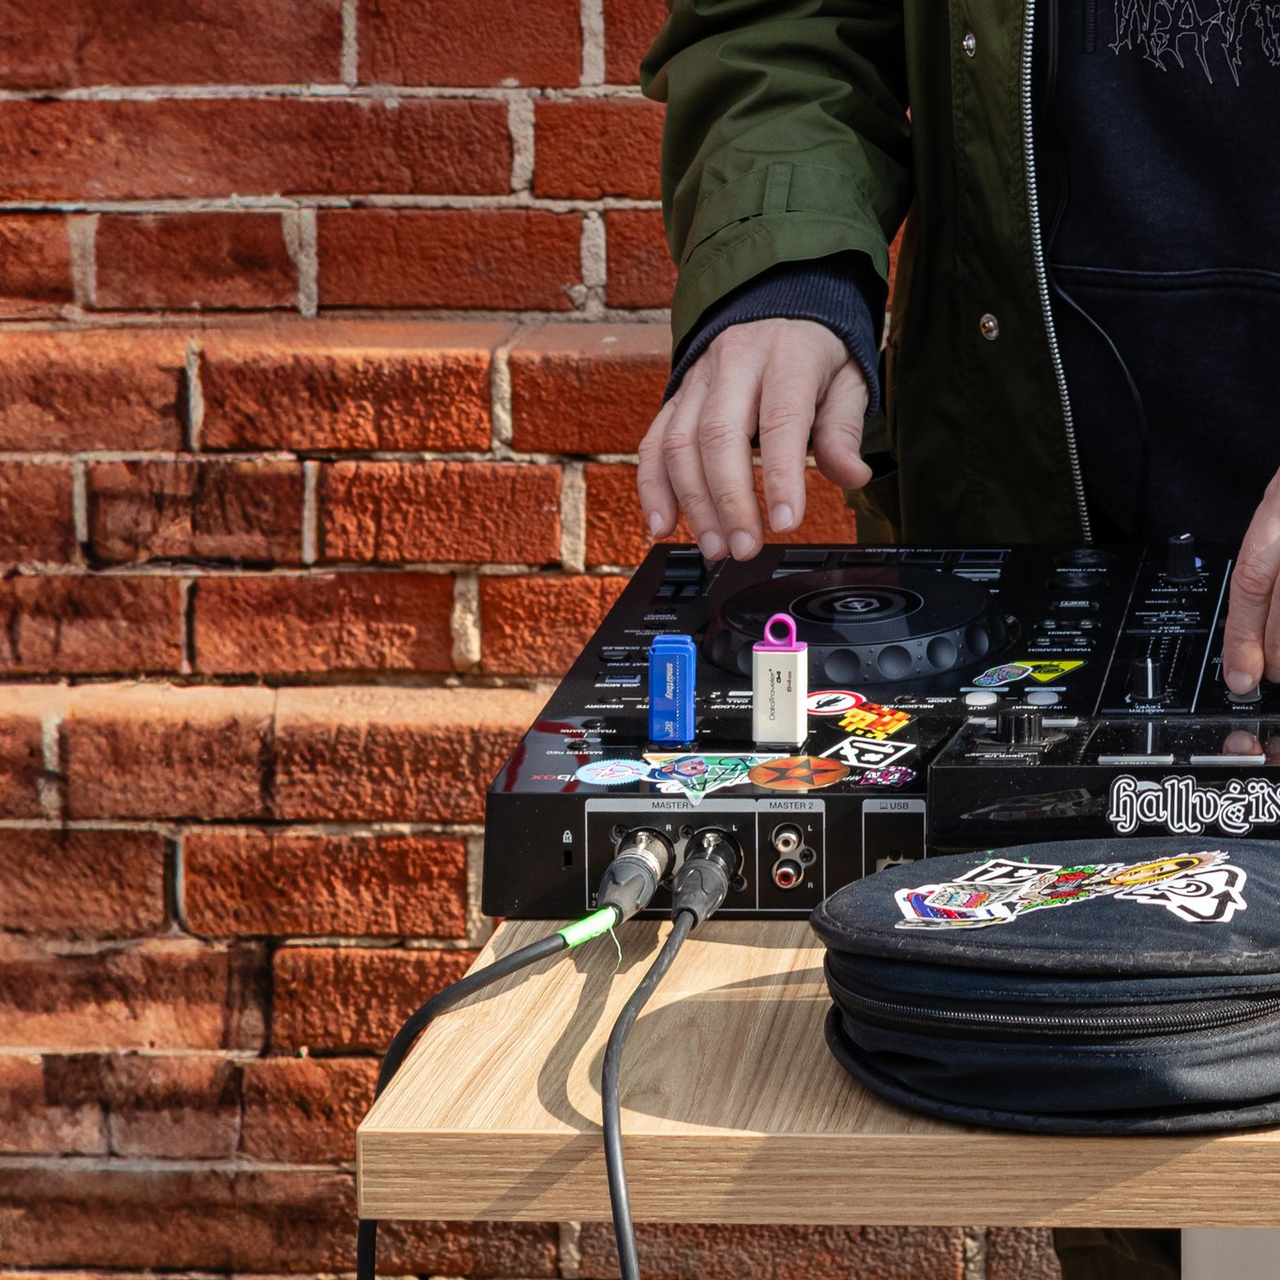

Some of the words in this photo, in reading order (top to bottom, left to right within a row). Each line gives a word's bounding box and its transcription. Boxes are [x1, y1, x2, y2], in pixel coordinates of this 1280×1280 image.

[664, 662, 674, 700] smartbuy
[651, 801, 689, 810] MASTER
[769, 801, 806, 810] MASTER
[807, 801, 814, 810] 2
[890, 801, 909, 810] USB
